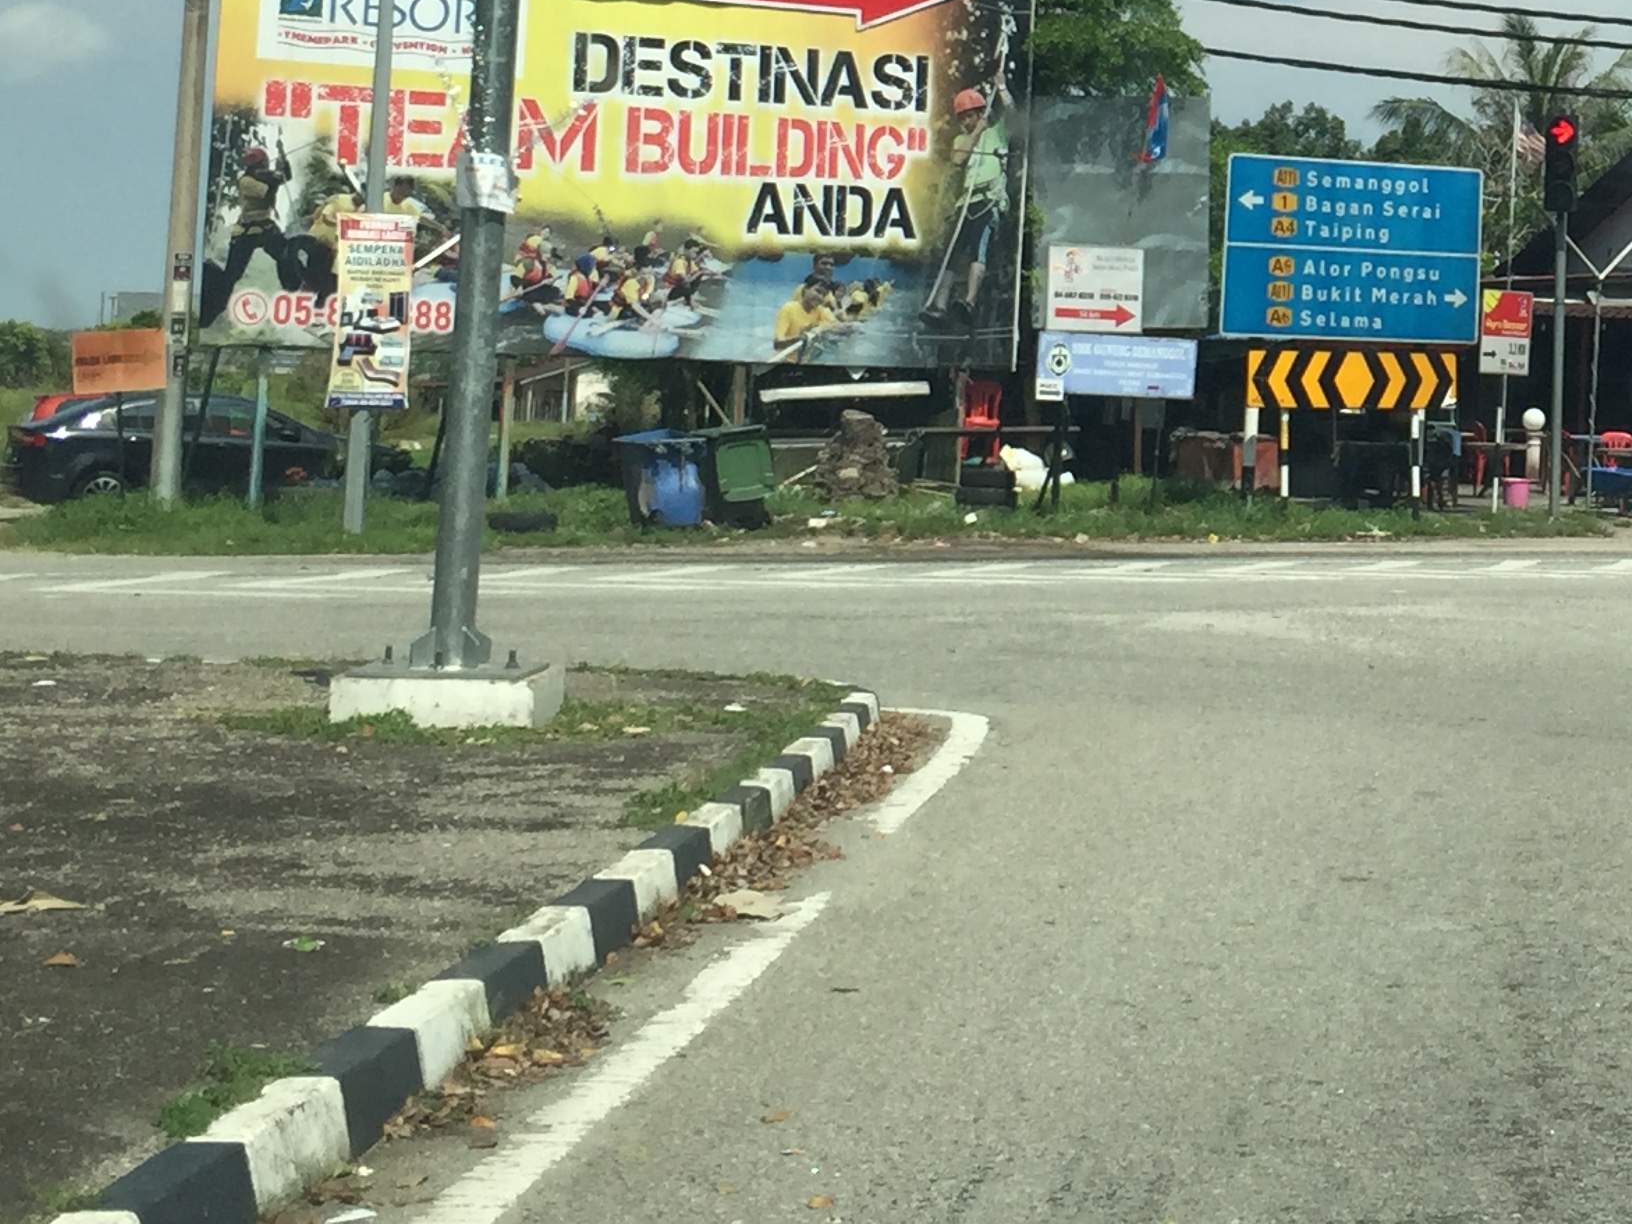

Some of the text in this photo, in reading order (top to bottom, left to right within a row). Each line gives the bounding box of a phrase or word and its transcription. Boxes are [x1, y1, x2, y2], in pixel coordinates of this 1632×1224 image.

[573, 31, 930, 112] DESTINASI
[1306, 171, 1430, 194] Semanggol
[746, 182, 917, 239] ANDA
[1305, 196, 1373, 217] Bagan
[1383, 200, 1441, 219] Serai
[1274, 220, 1390, 243] A4 Taiping
[1303, 259, 1351, 277] Alor
[1361, 263, 1440, 282] Pongsu
[1301, 284, 1362, 303] Bukit
[1372, 288, 1437, 306] Merah
[1300, 310, 1383, 329] Selama
